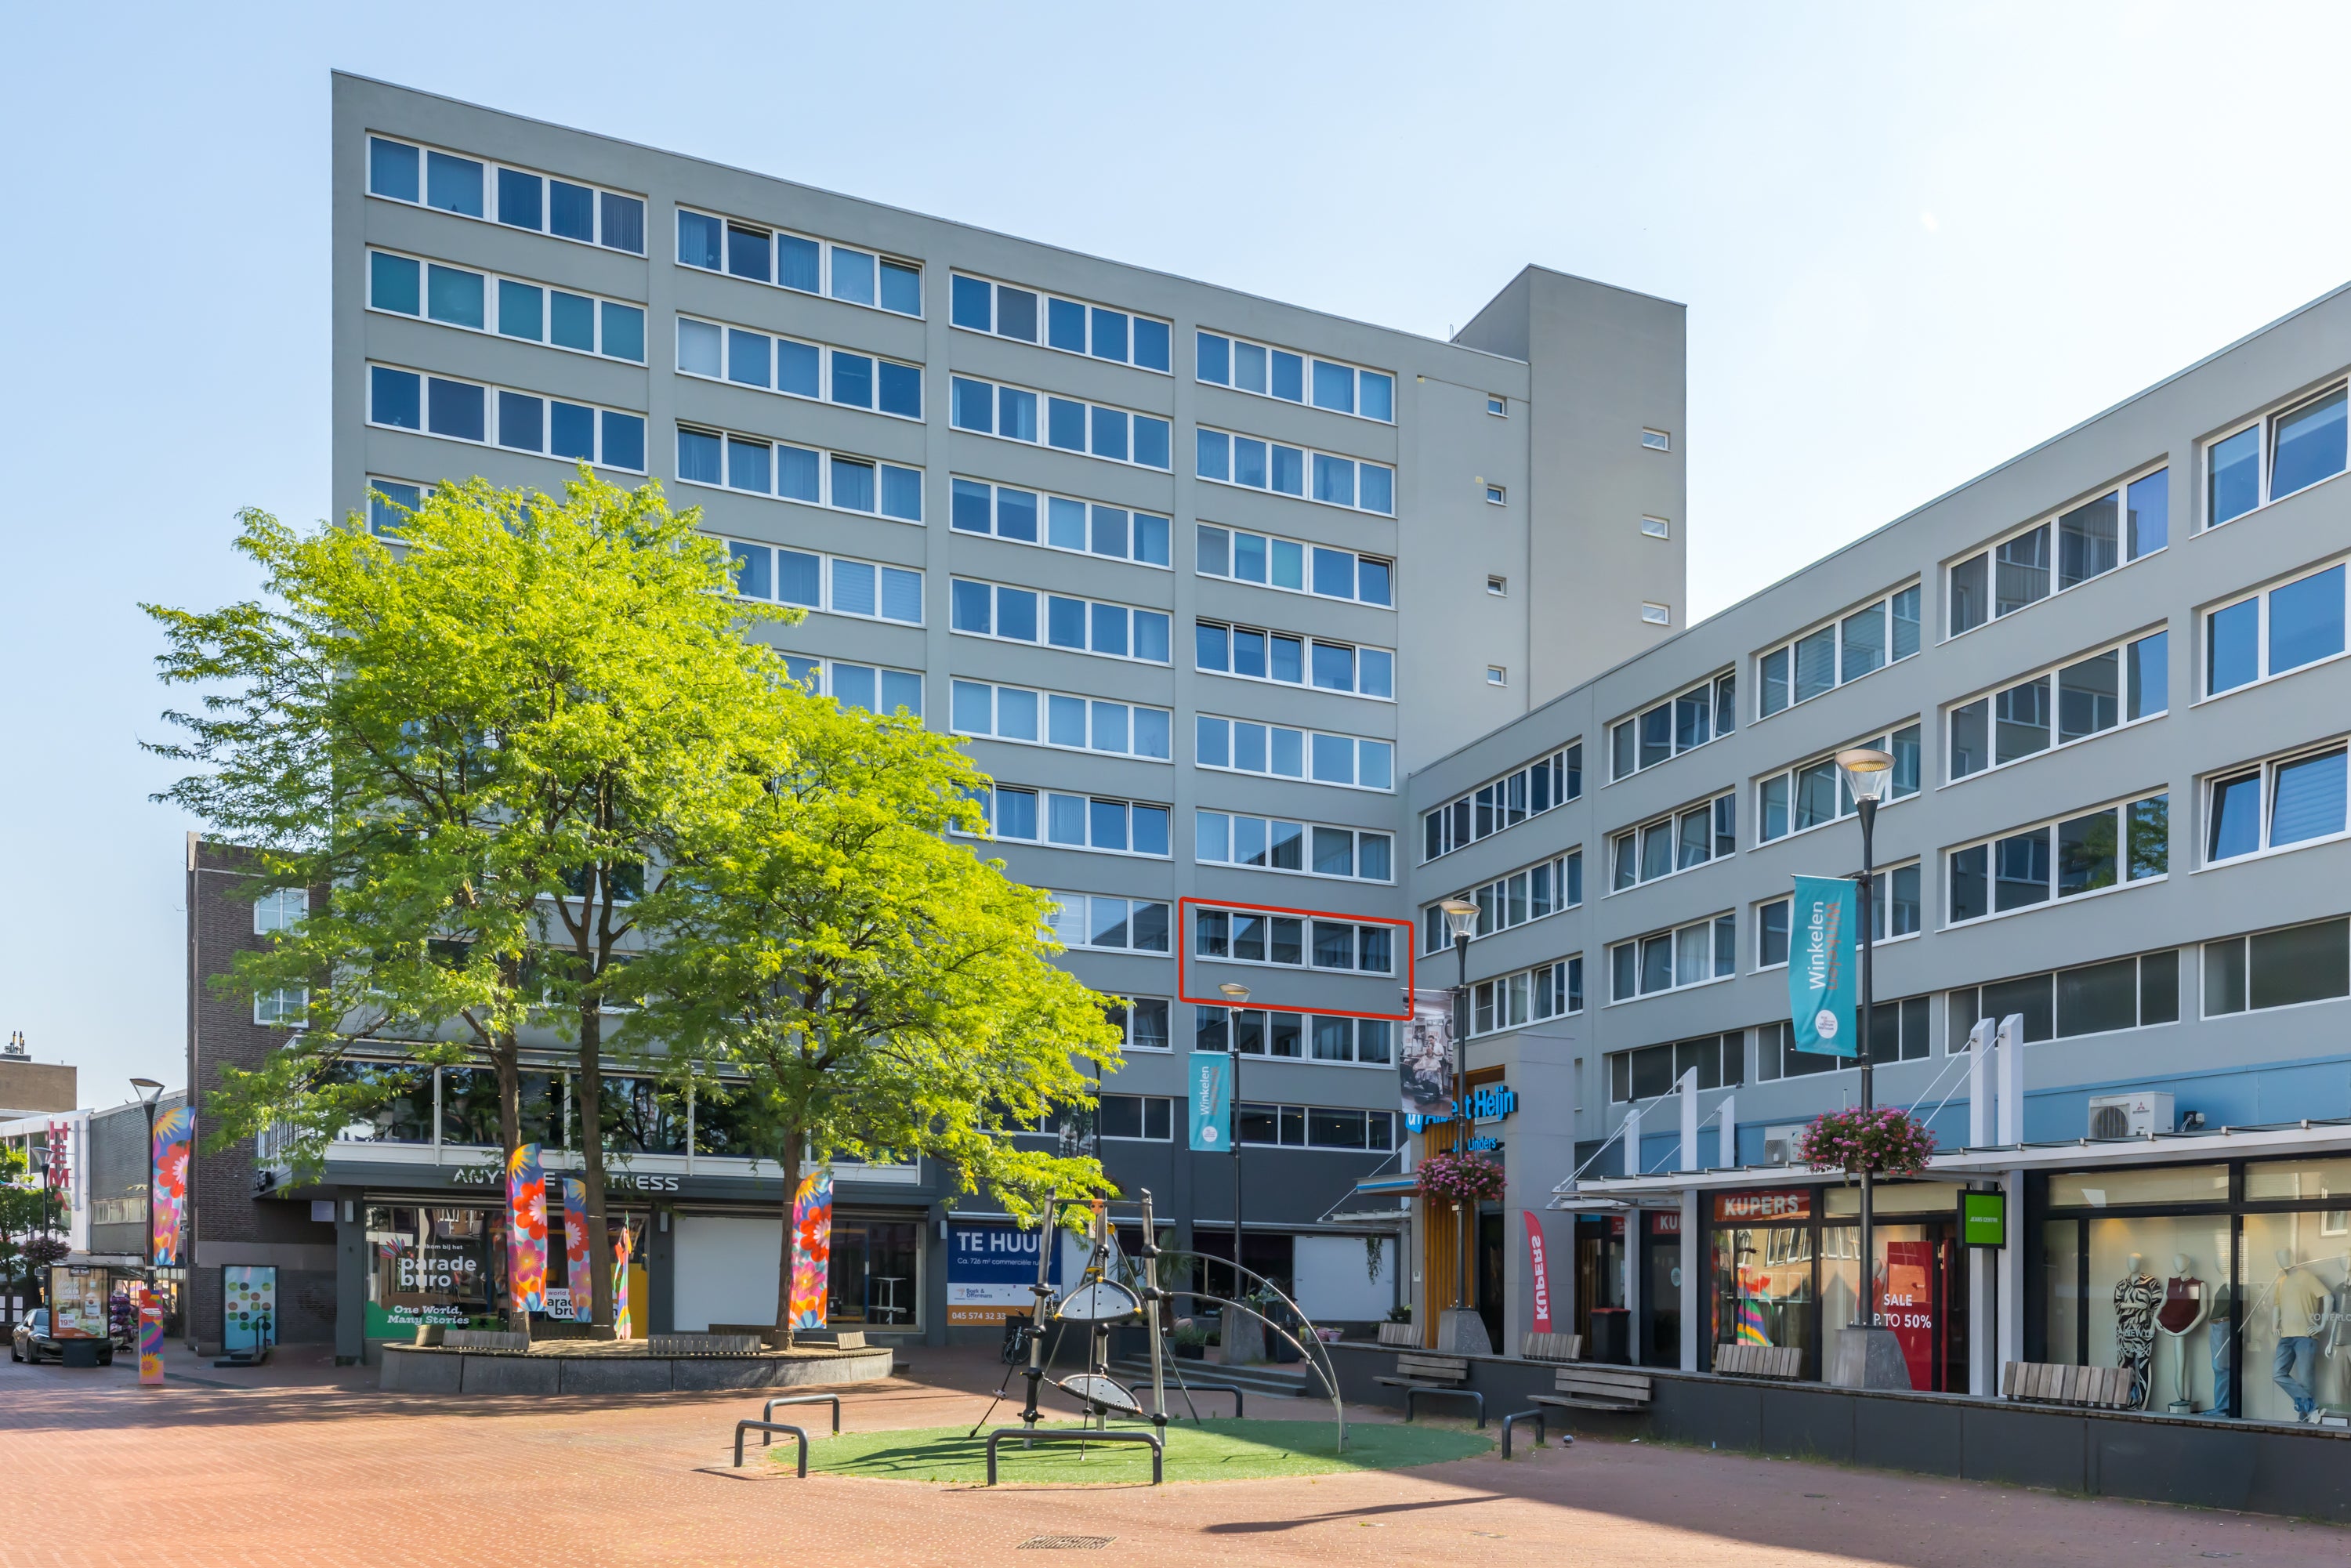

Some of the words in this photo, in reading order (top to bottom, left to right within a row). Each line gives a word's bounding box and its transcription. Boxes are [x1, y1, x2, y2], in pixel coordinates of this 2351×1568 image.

[1807, 901, 1826, 990] Winkelen
[1825, 902, 1842, 990] Winkelen
[1199, 1066, 1210, 1116] Winkelen
[1475, 1085, 1514, 1121] Heijn
[1468, 1136, 1497, 1151] Linders
[1725, 1194, 1799, 1216] KUPERS
[957, 1232, 984, 1251] TE
[400, 1255, 477, 1273] parade
[400, 1270, 451, 1287] buro
[1883, 1293, 1913, 1306] SALE
[393, 1305, 419, 1314] One
[422, 1305, 463, 1316] World,
[387, 1316, 422, 1326] Many
[425, 1316, 470, 1324] Stories
[1883, 1313, 1900, 1327] TO
[1904, 1314, 1932, 1328] 50%
